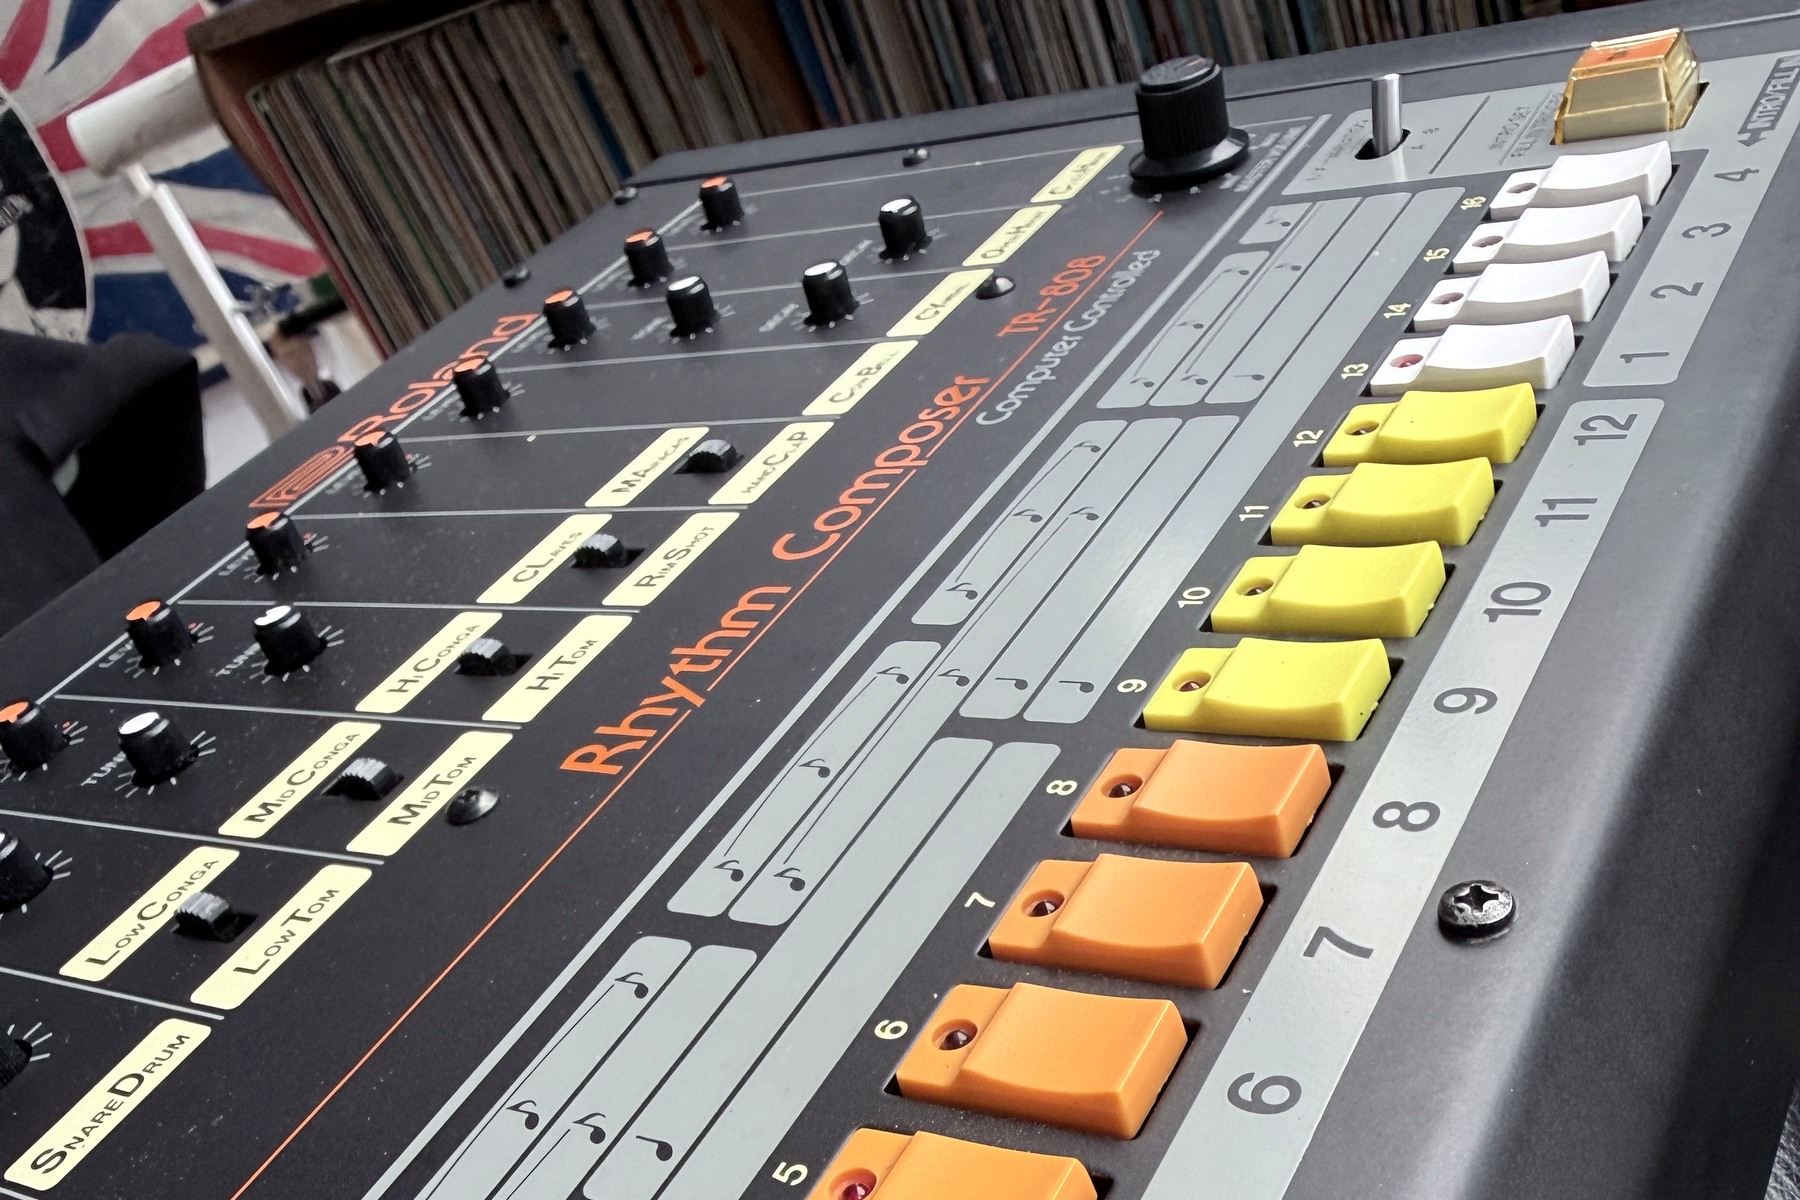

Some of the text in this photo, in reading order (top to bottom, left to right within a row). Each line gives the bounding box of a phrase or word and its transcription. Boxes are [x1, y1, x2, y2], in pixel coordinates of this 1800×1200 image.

[1714, 168, 1759, 181] 4
[1682, 223, 1731, 238] 3
[1423, 247, 1450, 262] 15
[997, 255, 1106, 337] TR-808
[1650, 282, 1704, 299] 2
[1383, 302, 1411, 318] 14
[1620, 351, 1670, 364] 1
[975, 336, 1083, 426] Computer
[1341, 362, 1370, 380] 13
[1294, 429, 1324, 448] 12
[1574, 413, 1638, 446] 12
[1239, 504, 1270, 522] 11
[1535, 497, 1598, 527] 11
[559, 375, 991, 776] Rhythm Composer
[1178, 586, 1211, 608] 10
[1484, 581, 1552, 623] 10
[1117, 678, 1148, 693] 9
[1434, 687, 1498, 714] 9
[1046, 780, 1077, 797] 8
[1373, 801, 1441, 832] 8
[965, 891, 996, 911] 7
[1303, 926, 1374, 960] 7
[874, 1018, 909, 1040] 6
[1227, 1072, 1302, 1115] 6
[772, 1161, 808, 1186] 5
